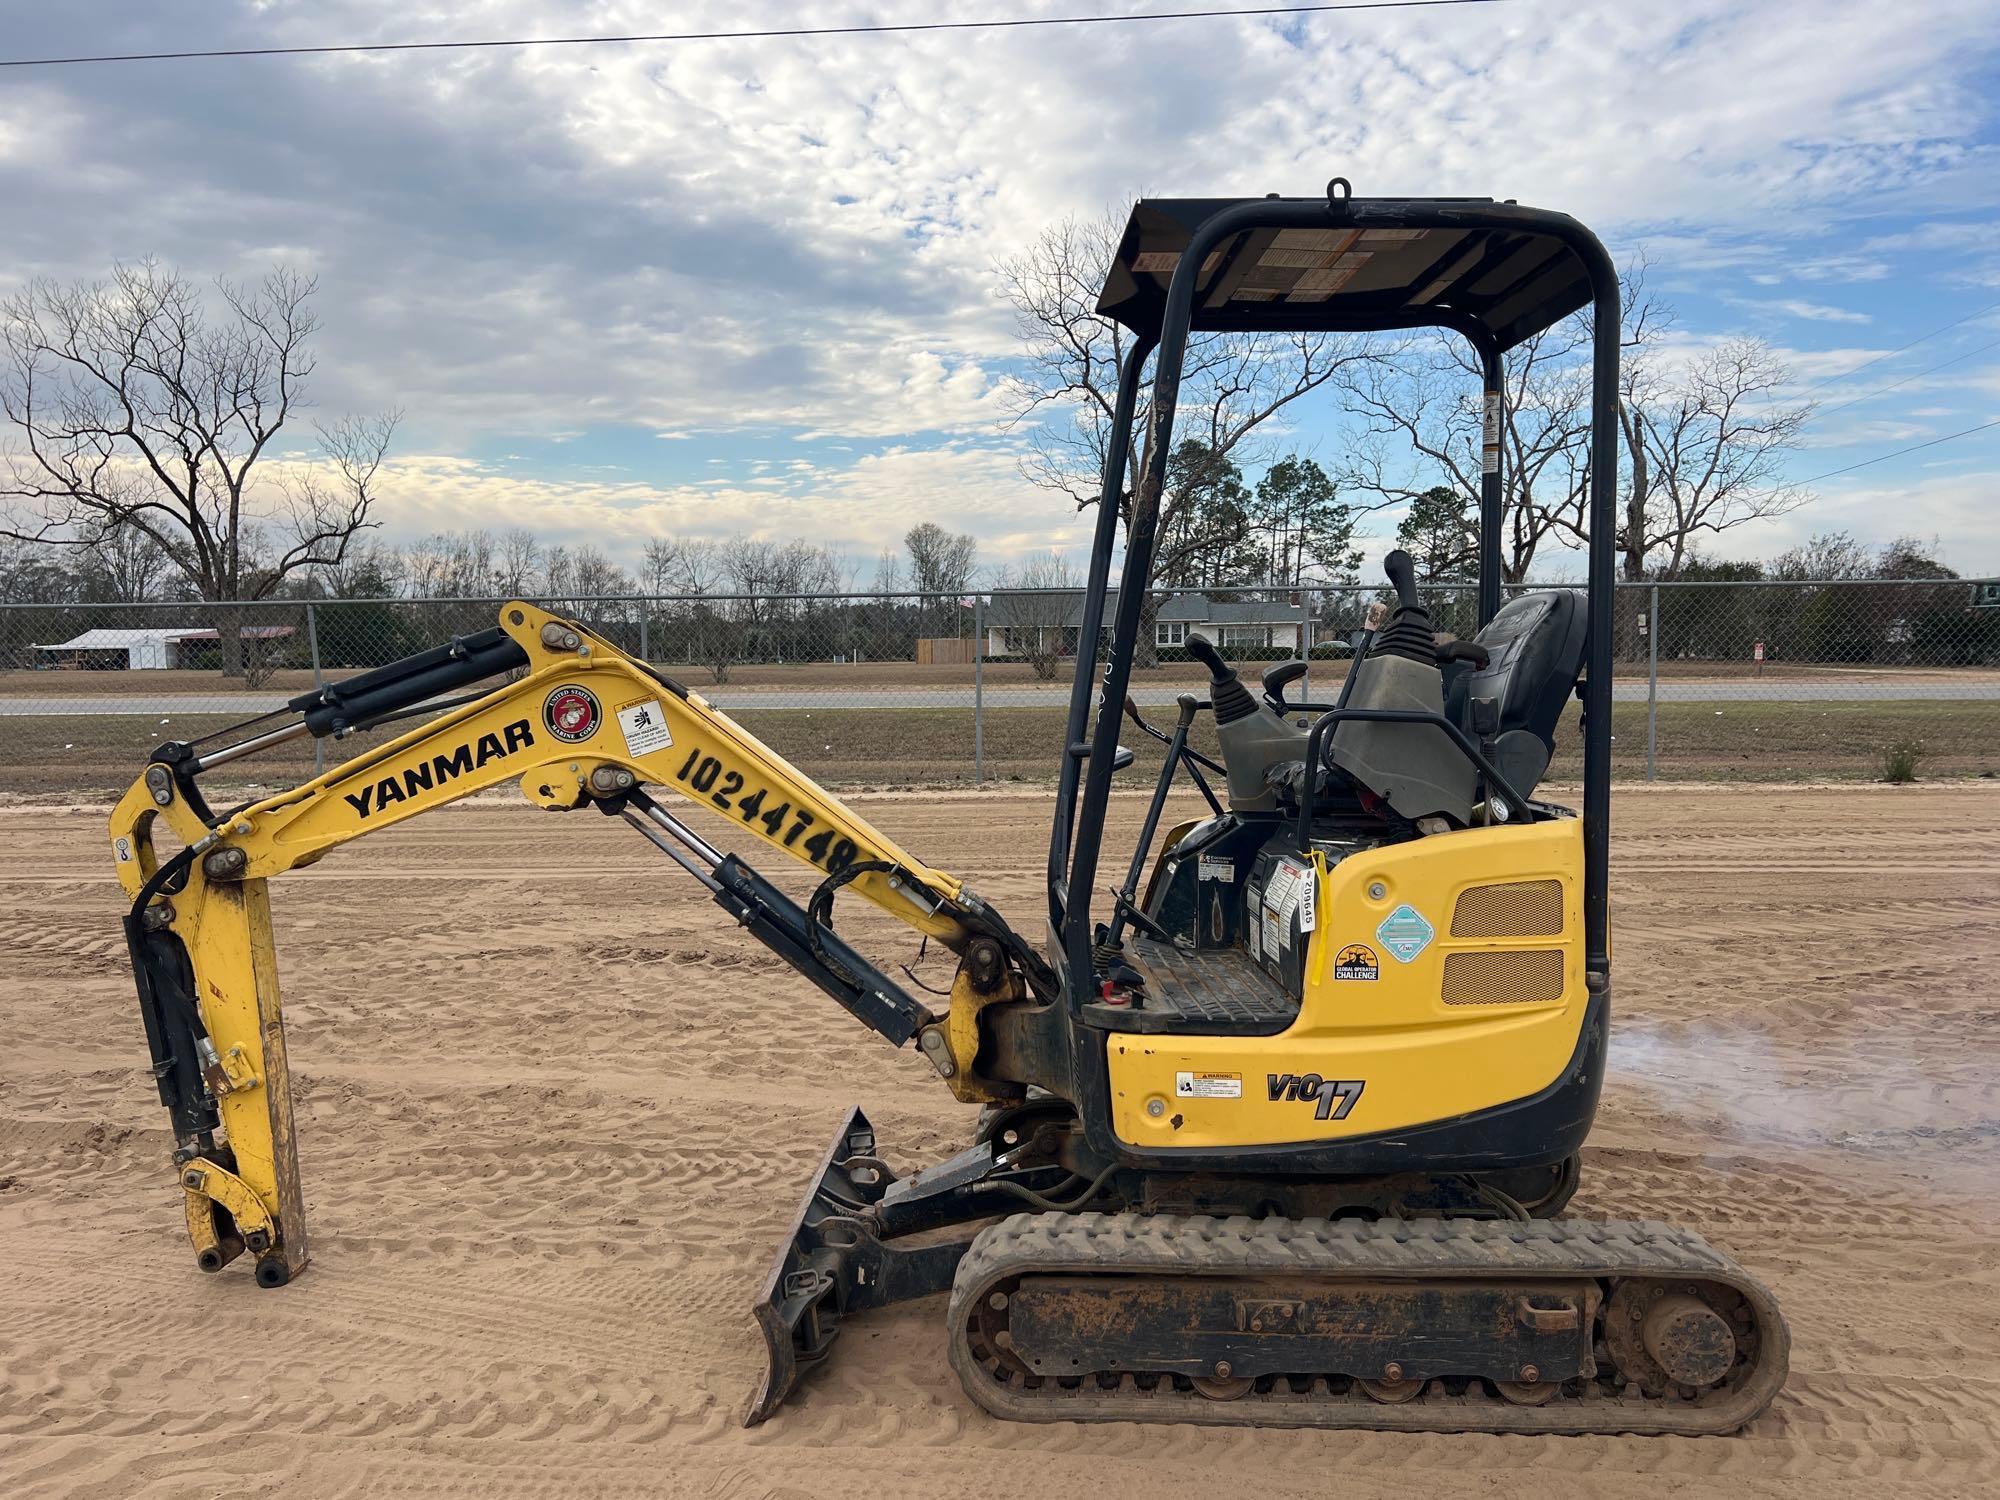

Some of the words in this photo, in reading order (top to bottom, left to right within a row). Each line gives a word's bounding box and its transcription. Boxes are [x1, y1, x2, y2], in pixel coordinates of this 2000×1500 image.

[549, 690, 569, 706] UNITED
[571, 689, 591, 702] STATES
[626, 697, 652, 708] WARNING
[551, 724, 575, 739] MARINE
[580, 720, 596, 738] CORPS
[344, 719, 534, 819] YANMAR
[677, 748, 858, 873] 10244748
[1303, 881, 1313, 924] 209645
[1336, 971, 1377, 979] CHALLENGE
